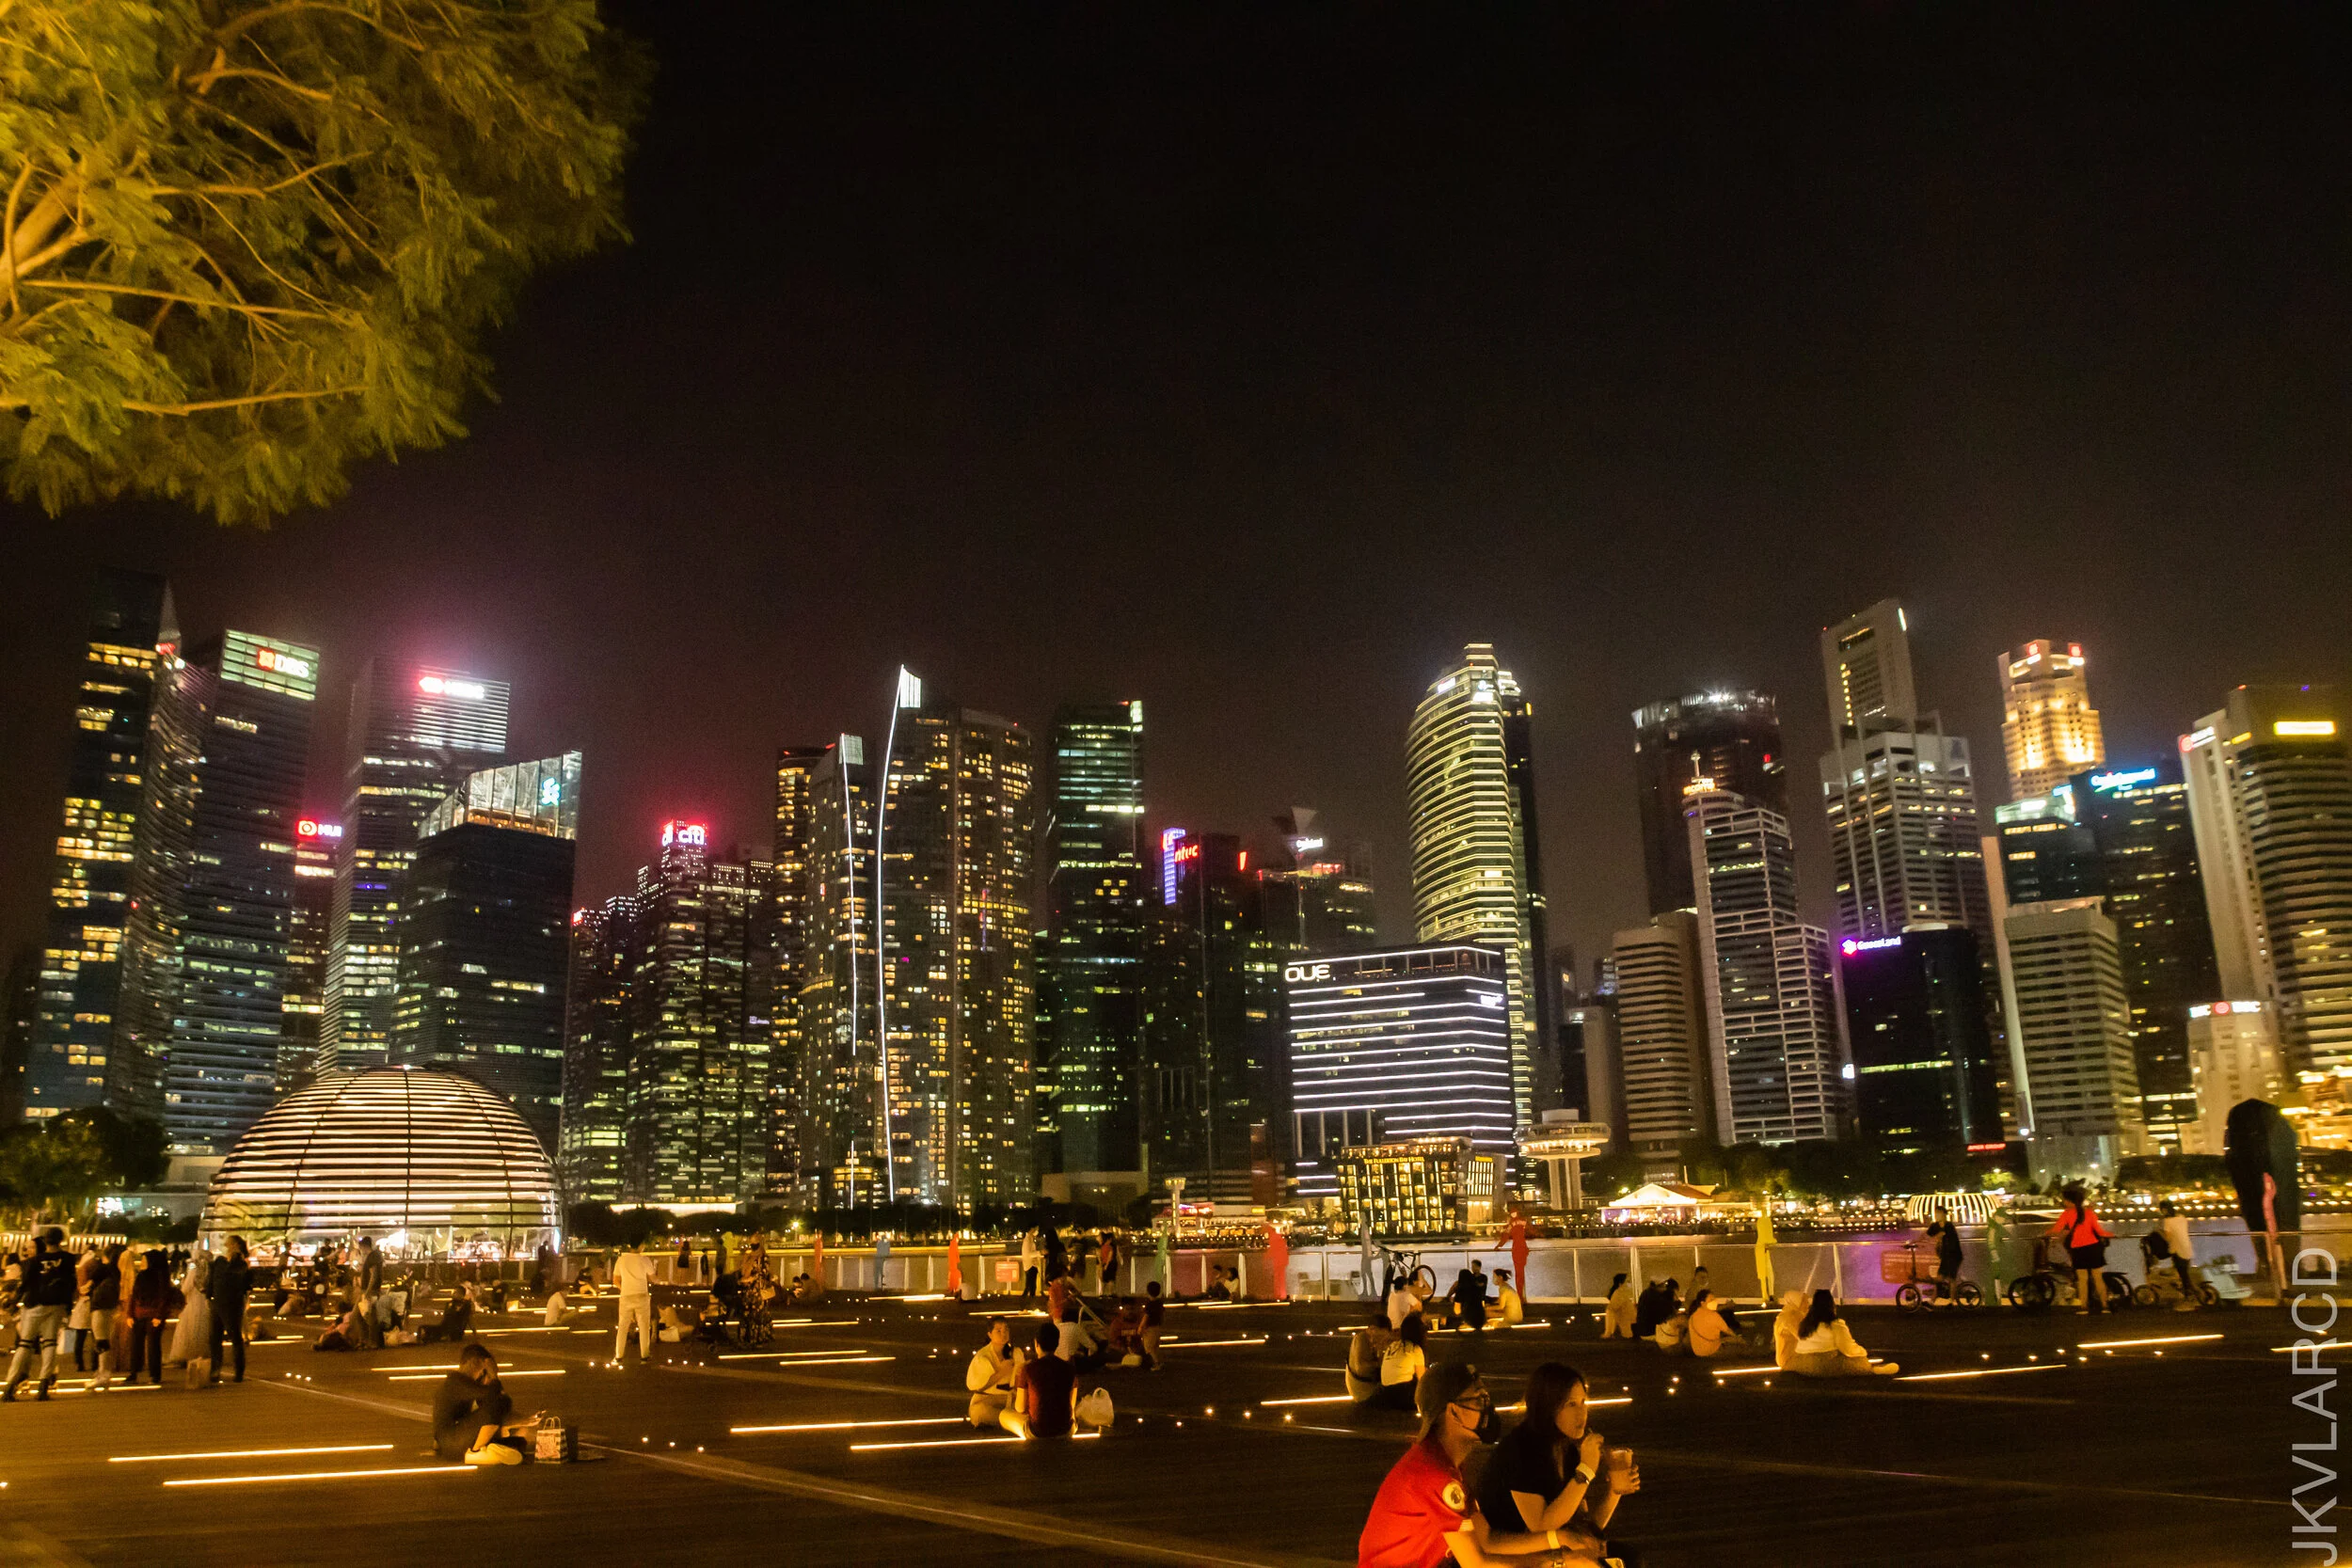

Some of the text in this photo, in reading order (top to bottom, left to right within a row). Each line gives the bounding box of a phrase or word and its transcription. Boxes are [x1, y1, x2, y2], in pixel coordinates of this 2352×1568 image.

[274, 653, 310, 678] DBS
[677, 825, 705, 846] citi
[1174, 844, 1199, 863] ntuc
[1284, 963, 1331, 983] OUE
